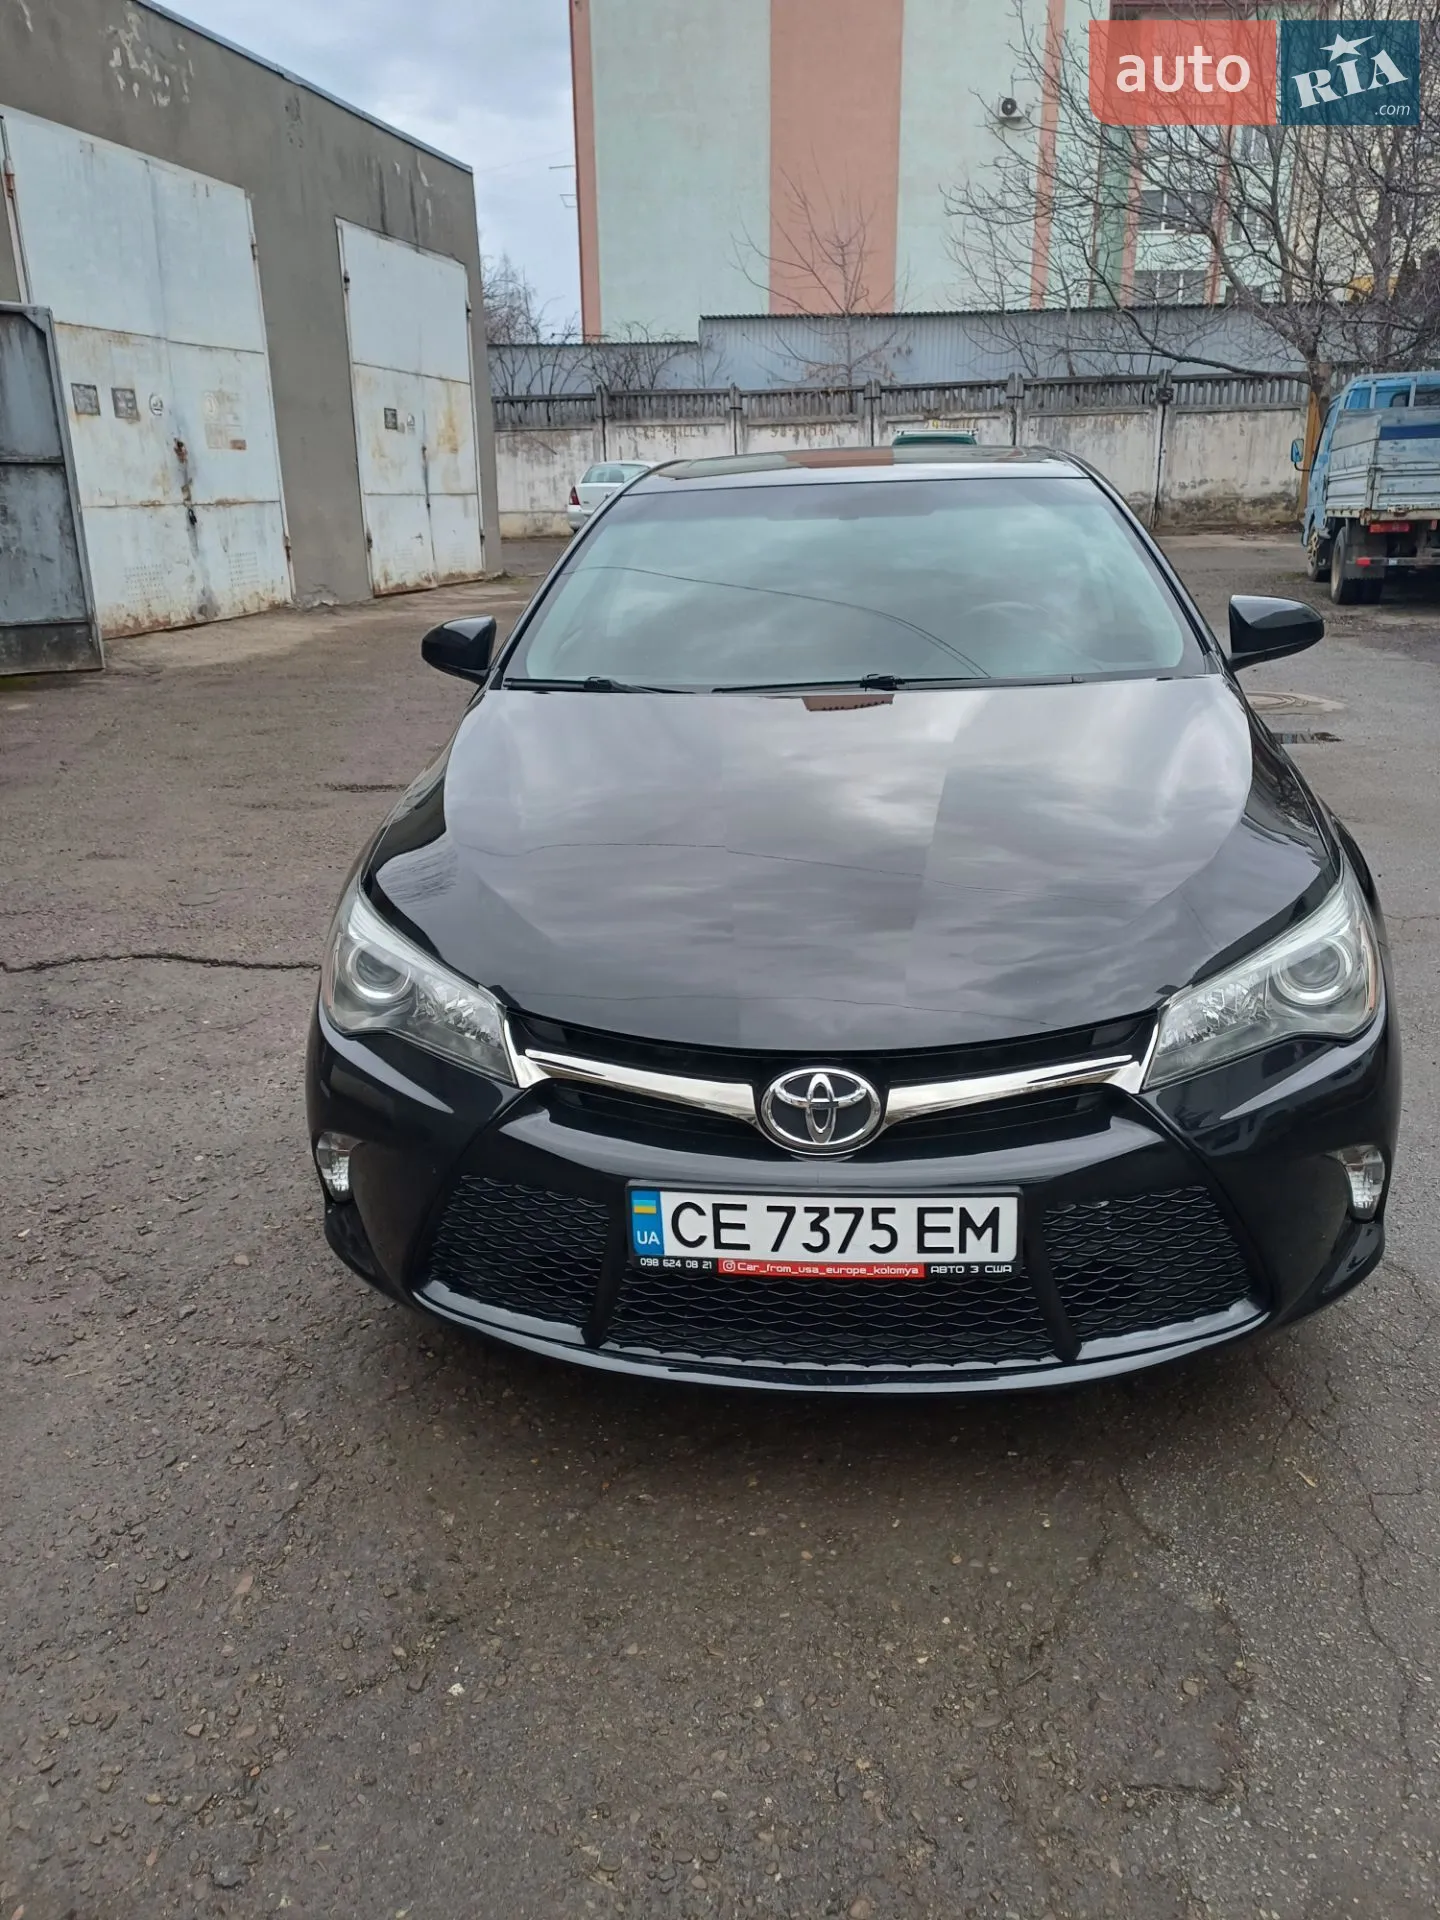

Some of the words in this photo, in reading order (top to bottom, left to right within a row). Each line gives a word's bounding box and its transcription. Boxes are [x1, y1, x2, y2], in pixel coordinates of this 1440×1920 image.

[671, 1201, 751, 1251] CE
[766, 1205, 899, 1255] 7375
[917, 1206, 1000, 1254] EM
[636, 1230, 660, 1245] UA
[640, 1257, 659, 1267] 098
[685, 1260, 699, 1269] 08
[702, 1260, 712, 1269] 21
[984, 1264, 1012, 1273] США
